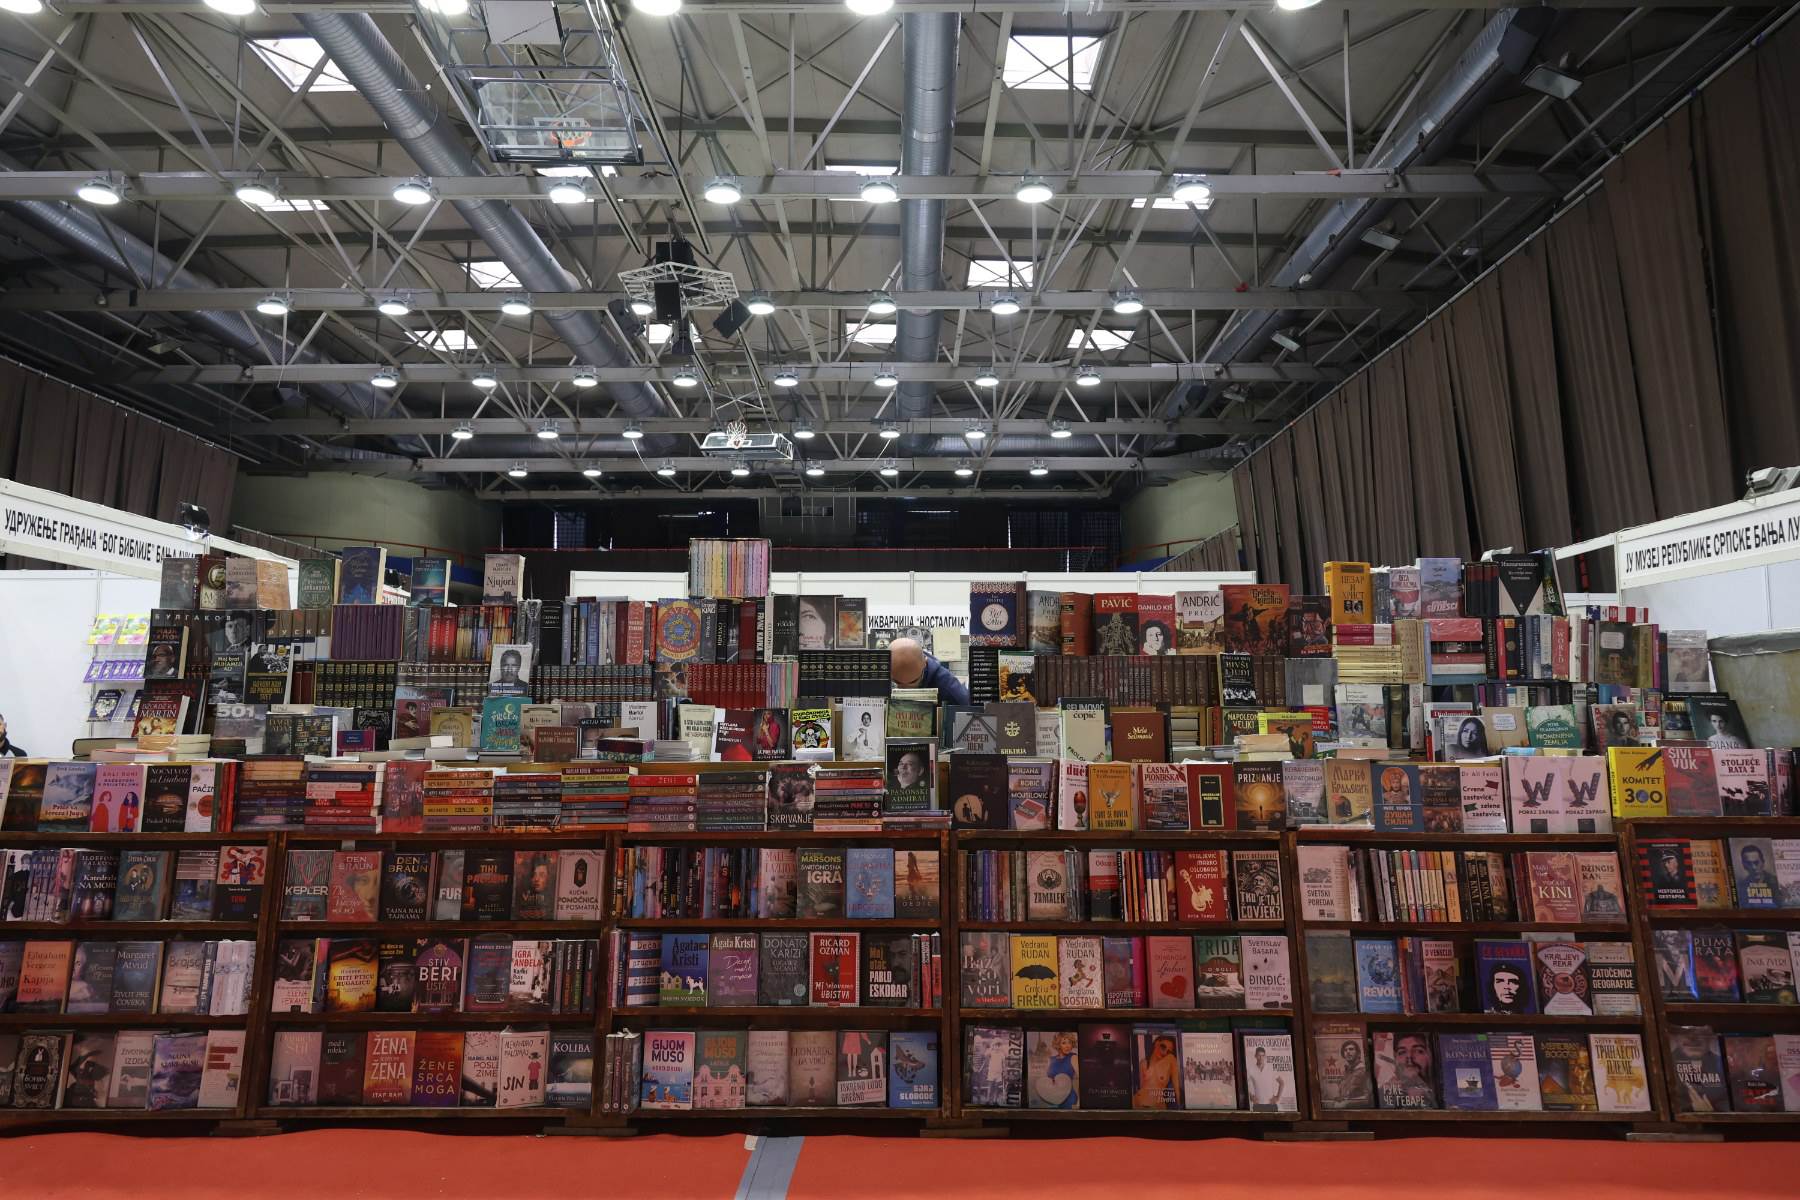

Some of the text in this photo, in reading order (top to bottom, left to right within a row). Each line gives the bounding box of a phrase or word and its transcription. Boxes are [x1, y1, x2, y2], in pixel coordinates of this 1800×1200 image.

[5, 508, 58, 541] УДРУЖЕЊЕ
[60, 522, 96, 551] ГРАЂАНА
[1626, 552, 1633, 573] ЈУ
[1635, 547, 1660, 572] МУЗЕЈ
[1661, 536, 1711, 565] РЕПУБЛИКЕ
[1713, 527, 1751, 556] СРПСКЕ
[1753, 519, 1786, 549] БАЊА
[486, 577, 516, 588] Njujork
[1101, 597, 1132, 608] PAVIĆ
[1137, 602, 1173, 611] DANILO KIŠ
[1183, 595, 1220, 608] ANDRIĆ
[140, 709, 177, 718] MARTIN
[216, 706, 254, 718] 501
[1228, 713, 1258, 721] NAPOLEON
[1233, 721, 1254, 729] VELIKI
[1668, 748, 1691, 759] SIVI
[1673, 759, 1698, 770] VUK
[1721, 756, 1760, 767] STOLJEĆE
[1011, 767, 1039, 775] MIRJANA
[1146, 764, 1169, 774] ČASNA
[1728, 766, 1747, 774] RATA
[1238, 773, 1281, 783] PRIZNANJE
[1622, 776, 1661, 784] KOMITET
[1011, 790, 1048, 799] MOJSILOVIĆ
[1625, 788, 1663, 803] 300
[770, 814, 811, 824] SKRIVANJE
[396, 856, 420, 865] DEN
[801, 855, 841, 863] MARSONS
[338, 862, 373, 870] BRAUN
[389, 864, 429, 873] BRAUN
[807, 871, 843, 884] IGRA
[285, 886, 328, 896] KEPLER
[1540, 887, 1573, 899] KINI
[1034, 892, 1065, 904] ZAMALEK
[673, 937, 698, 952] Agata
[712, 938, 756, 948] Agata Kristi
[764, 939, 807, 948] DONATO
[1020, 940, 1048, 949] Vedrana
[1065, 940, 1093, 949] Vedrana
[1248, 939, 1281, 948] SVETISLAV
[117, 950, 156, 960] Margaret
[514, 950, 531, 958] IGRA
[819, 948, 850, 956] OZMAN
[1021, 949, 1049, 959] RUDAN
[1066, 949, 1095, 959] RUDAN
[1251, 947, 1278, 956] BASARA
[1696, 946, 1734, 956] RATA
[122, 961, 148, 969] Atvud
[428, 958, 449, 967] STIV
[673, 953, 698, 967] Kristi
[419, 967, 458, 981] BERI
[869, 970, 892, 983] PABLO
[1592, 966, 1632, 978] ZATOČENICI
[24, 974, 53, 985] Kapija
[1592, 978, 1635, 989] GEOGRAFIJE
[821, 990, 850, 999] UBISTVA
[869, 984, 908, 998] ESKOBAR
[1017, 995, 1056, 1007] FIRENCI
[1064, 996, 1099, 1006] DOSTAVA
[372, 1035, 408, 1055] ŽENA
[553, 1042, 591, 1053] KOLIBA
[652, 1039, 686, 1050] GIJOM
[651, 1051, 685, 1063] MUSO
[370, 1060, 406, 1080] ŽENA
[417, 1059, 456, 1071] ŽENE
[417, 1072, 454, 1083] SRCA
[1680, 1072, 1721, 1084] VATIKANA
[503, 1076, 525, 1091] SIN
[415, 1085, 456, 1095] MOGA
[1383, 1086, 1402, 1096] РУКЕ
[899, 1092, 934, 1100] SLOBODE
[1395, 1096, 1425, 1107] ГЕВАРЕ
